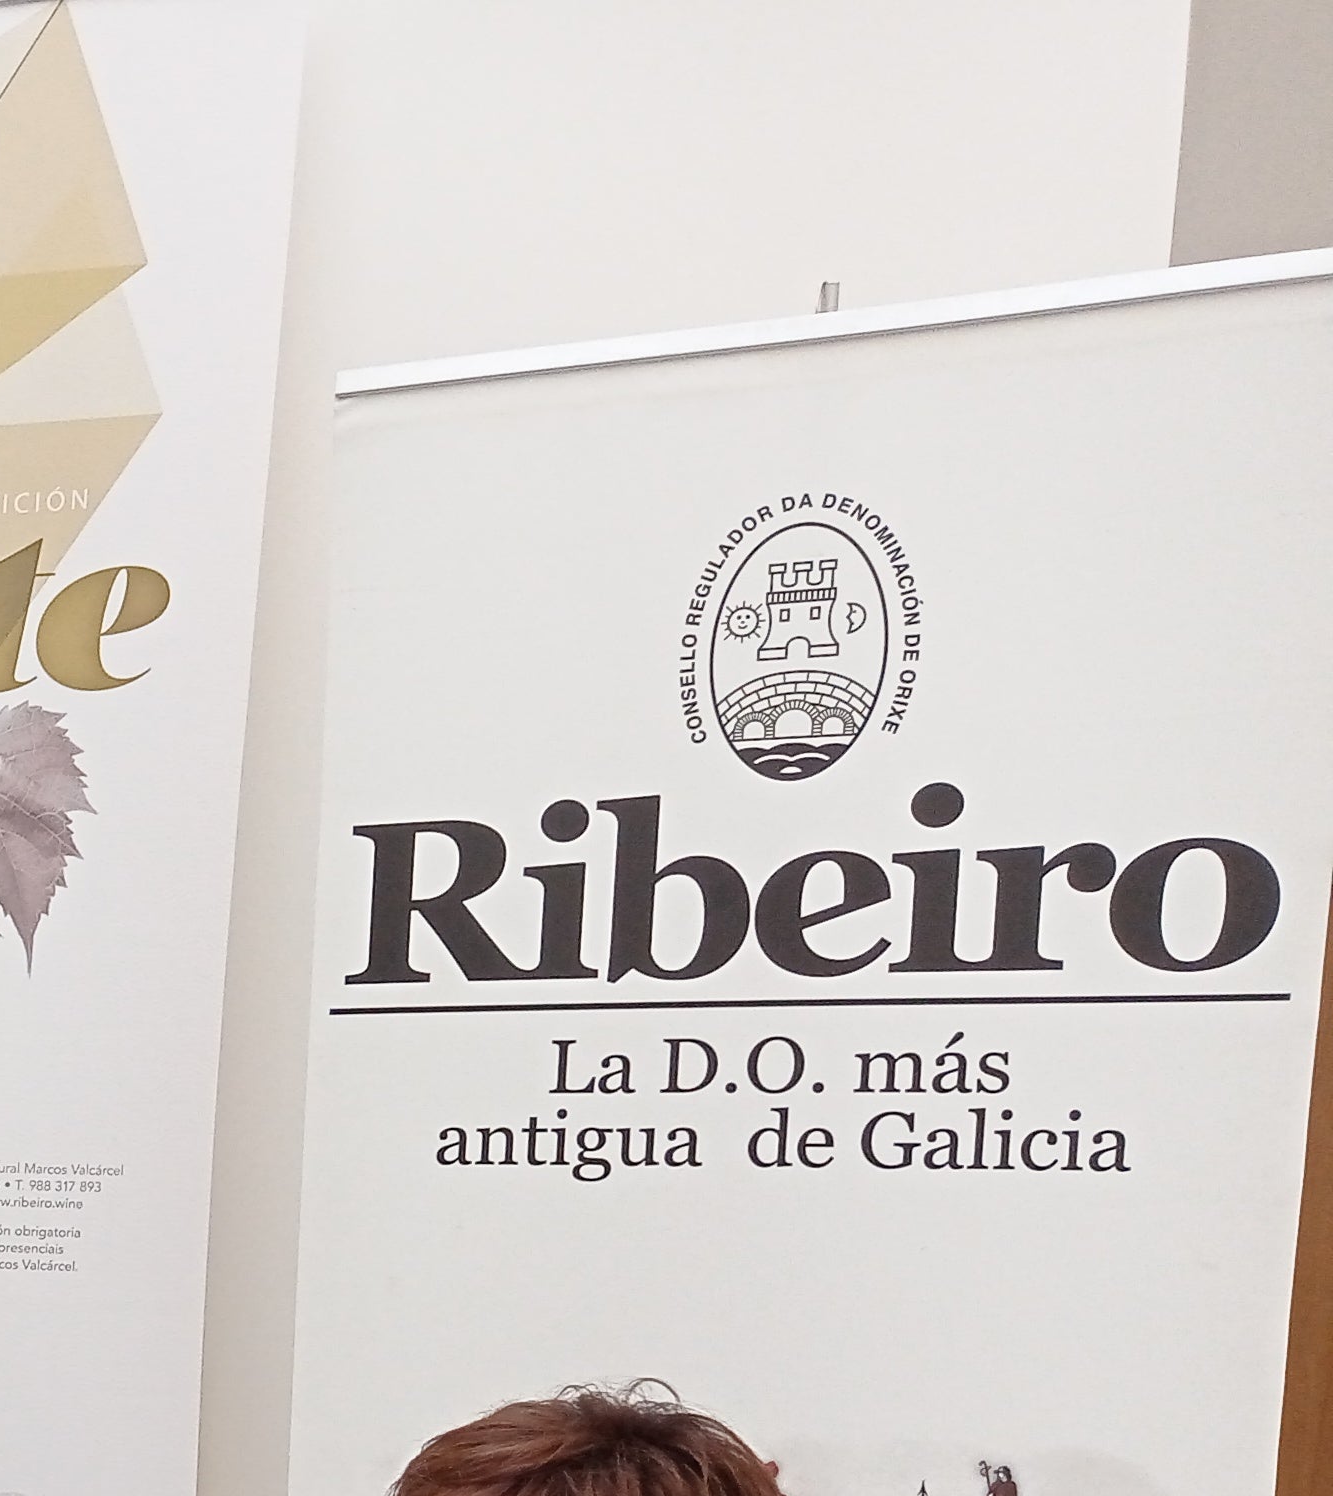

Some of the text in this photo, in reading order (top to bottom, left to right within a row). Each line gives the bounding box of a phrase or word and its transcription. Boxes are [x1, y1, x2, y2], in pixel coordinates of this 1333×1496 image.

[678, 493, 925, 745] CONSELLO REGULADOR DA DENOMINACIÓN DE ORIXE
[344, 781, 1281, 985] Ribeiro
[549, 1031, 1012, 1098] La D.O. más
[435, 1107, 1132, 1183] antigua de Galicia
[23, 1162, 68, 1176] Marcos
[70, 1162, 124, 1177] Valcárcel
[28, 1179, 49, 1192] 988
[52, 1180, 75, 1192] 317
[79, 1180, 102, 1193] 893
[14, 1223, 81, 1240] obrigatoria
[21, 1257, 79, 1272] Valcárcel.
